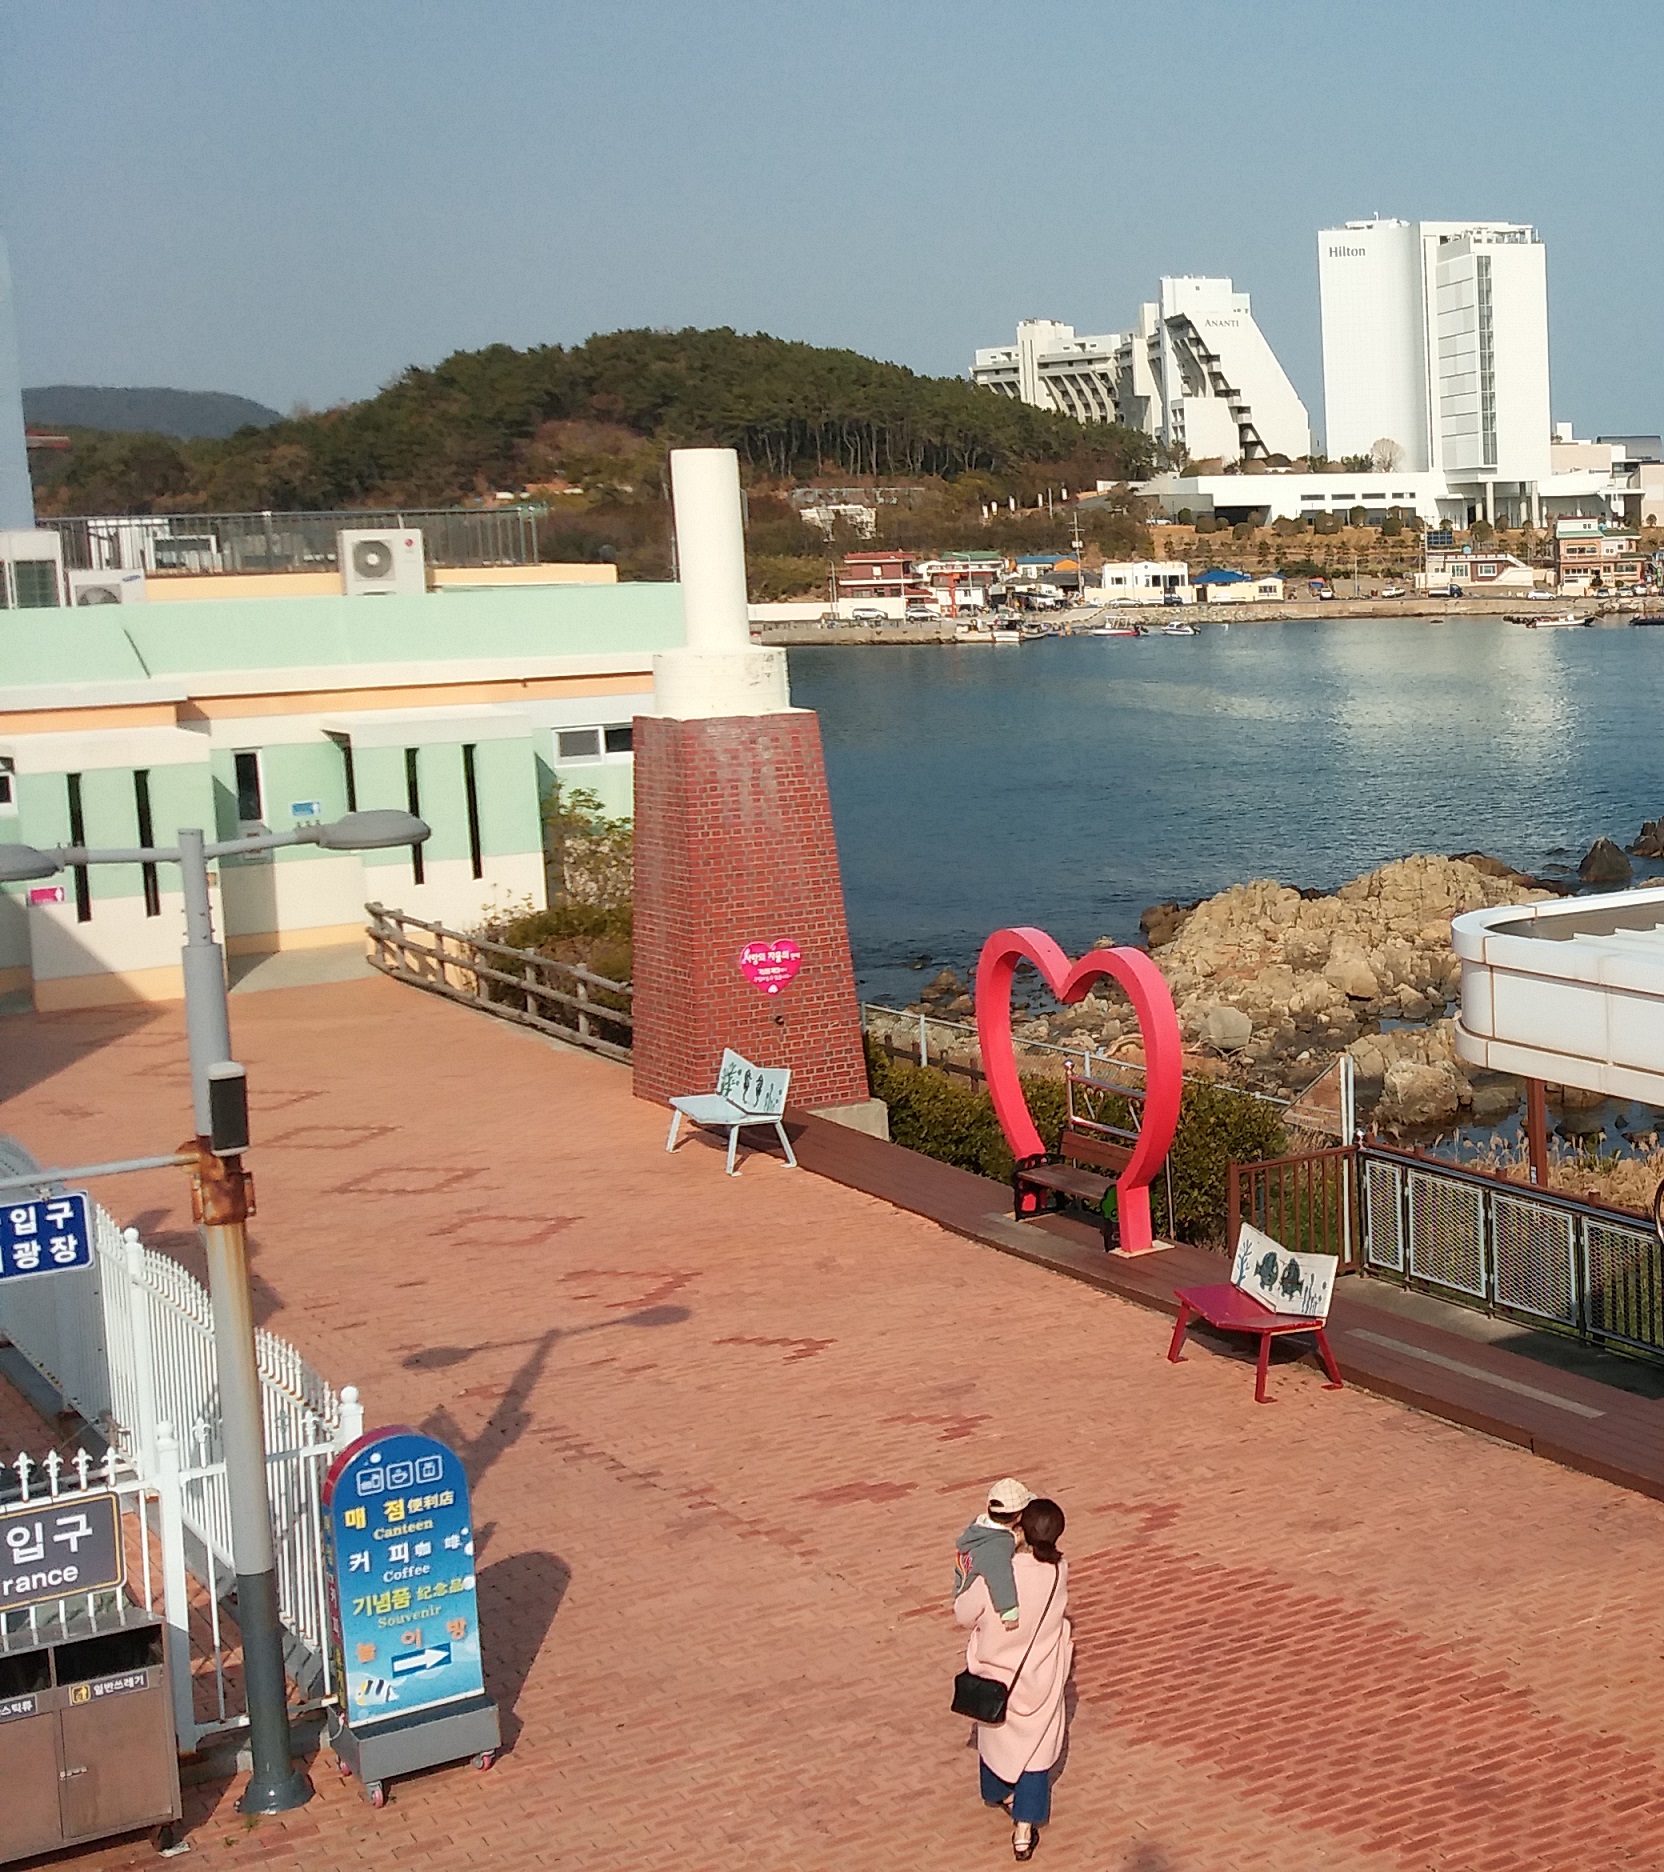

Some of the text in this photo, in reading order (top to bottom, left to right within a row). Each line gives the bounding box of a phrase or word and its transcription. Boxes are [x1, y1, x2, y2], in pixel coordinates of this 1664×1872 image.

[1329, 245, 1366, 258] Hilton
[1205, 319, 1239, 327] ANANTI
[9, 1200, 75, 1236] 입구
[12, 1233, 79, 1269] 광장
[407, 1491, 454, 1514] 便利店
[6, 1513, 93, 1566] 입구
[373, 1519, 434, 1541] Canteen
[1, 1565, 79, 1597] rance
[383, 1564, 430, 1583] Coffee
[352, 1586, 411, 1617] 기념품
[377, 1604, 442, 1629] Souvenir
[93, 1675, 144, 1696] 일반쓰레기
[0, 1700, 33, 1716] 스틱류
